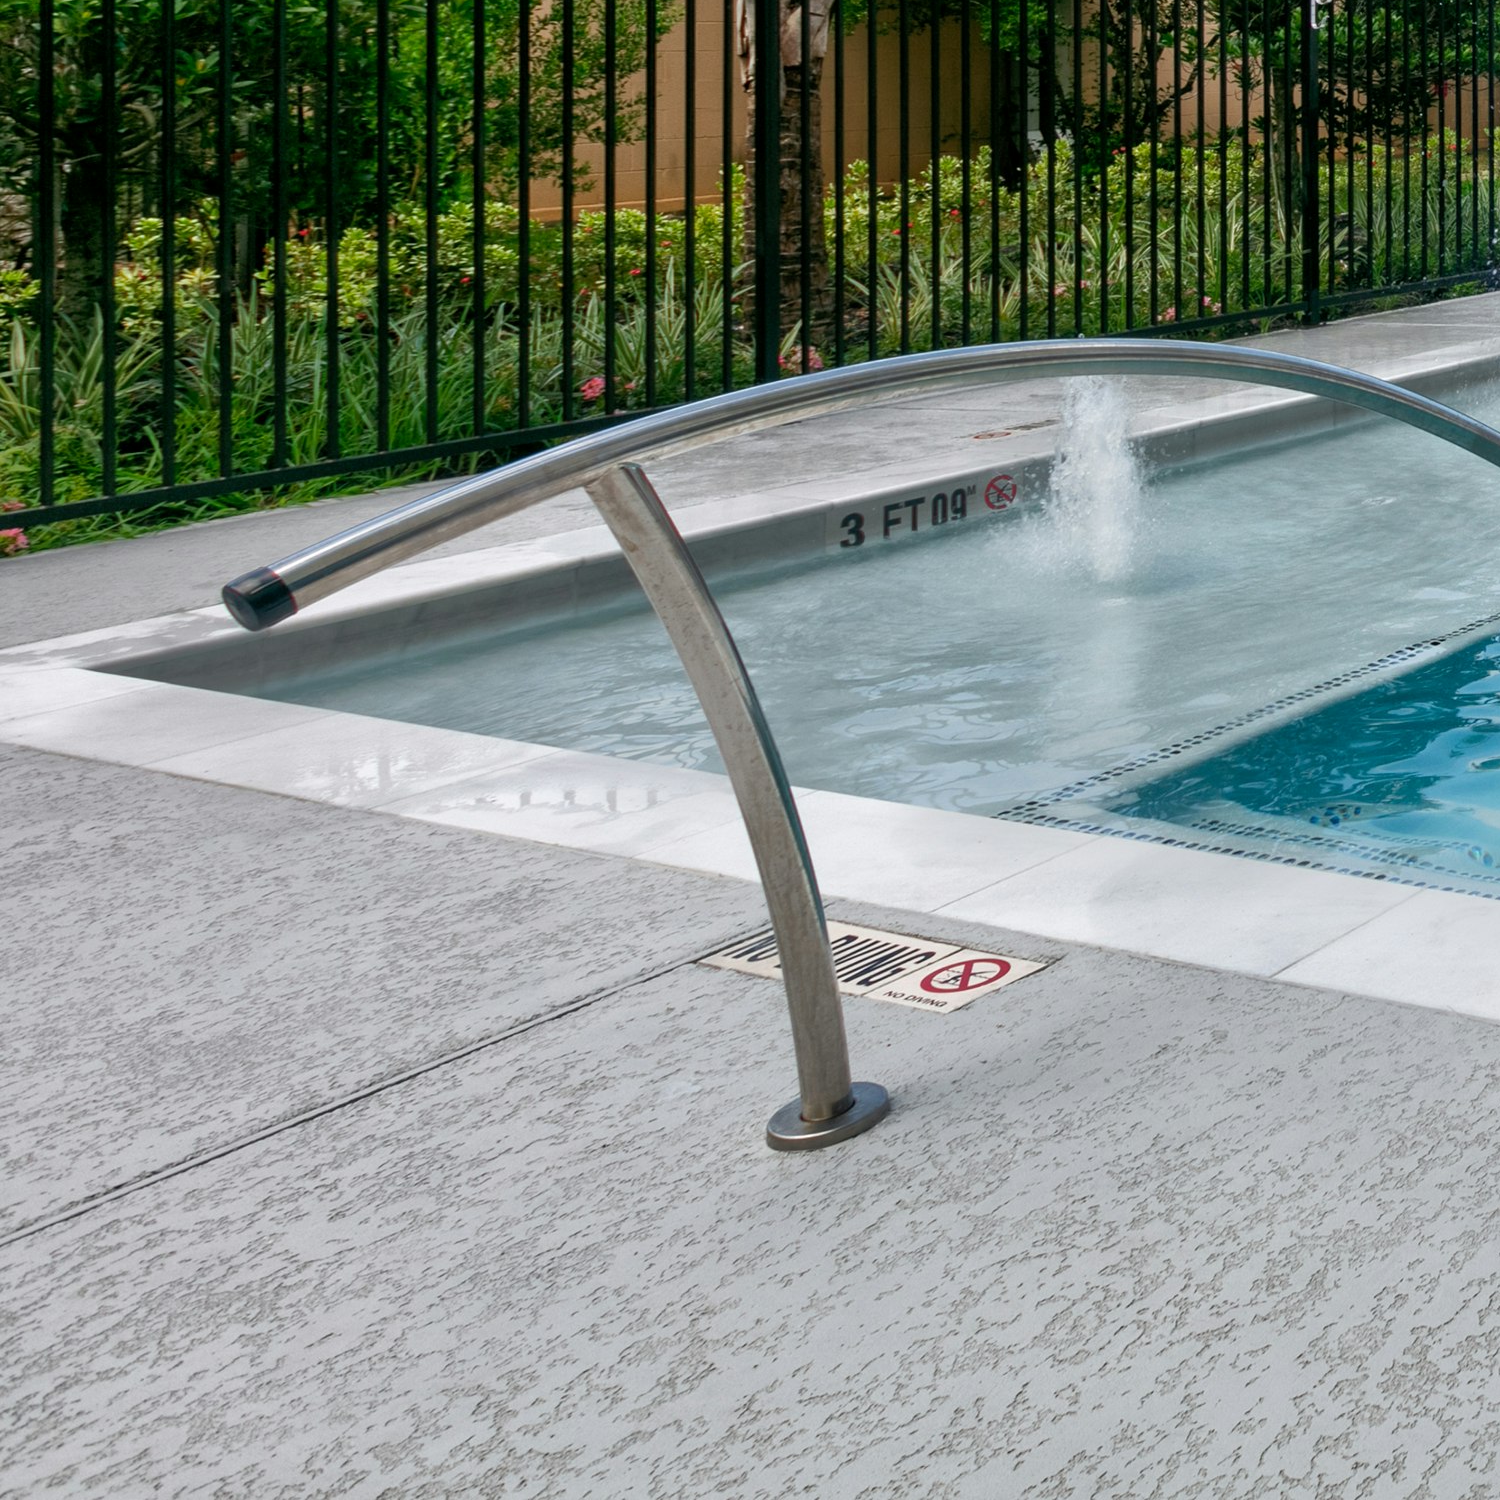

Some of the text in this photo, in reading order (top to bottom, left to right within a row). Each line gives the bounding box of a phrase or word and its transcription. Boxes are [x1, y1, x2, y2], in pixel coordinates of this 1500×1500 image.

[840, 512, 866, 548] 3
[882, 496, 926, 539] FT
[883, 990, 948, 1007] NO DIVING
